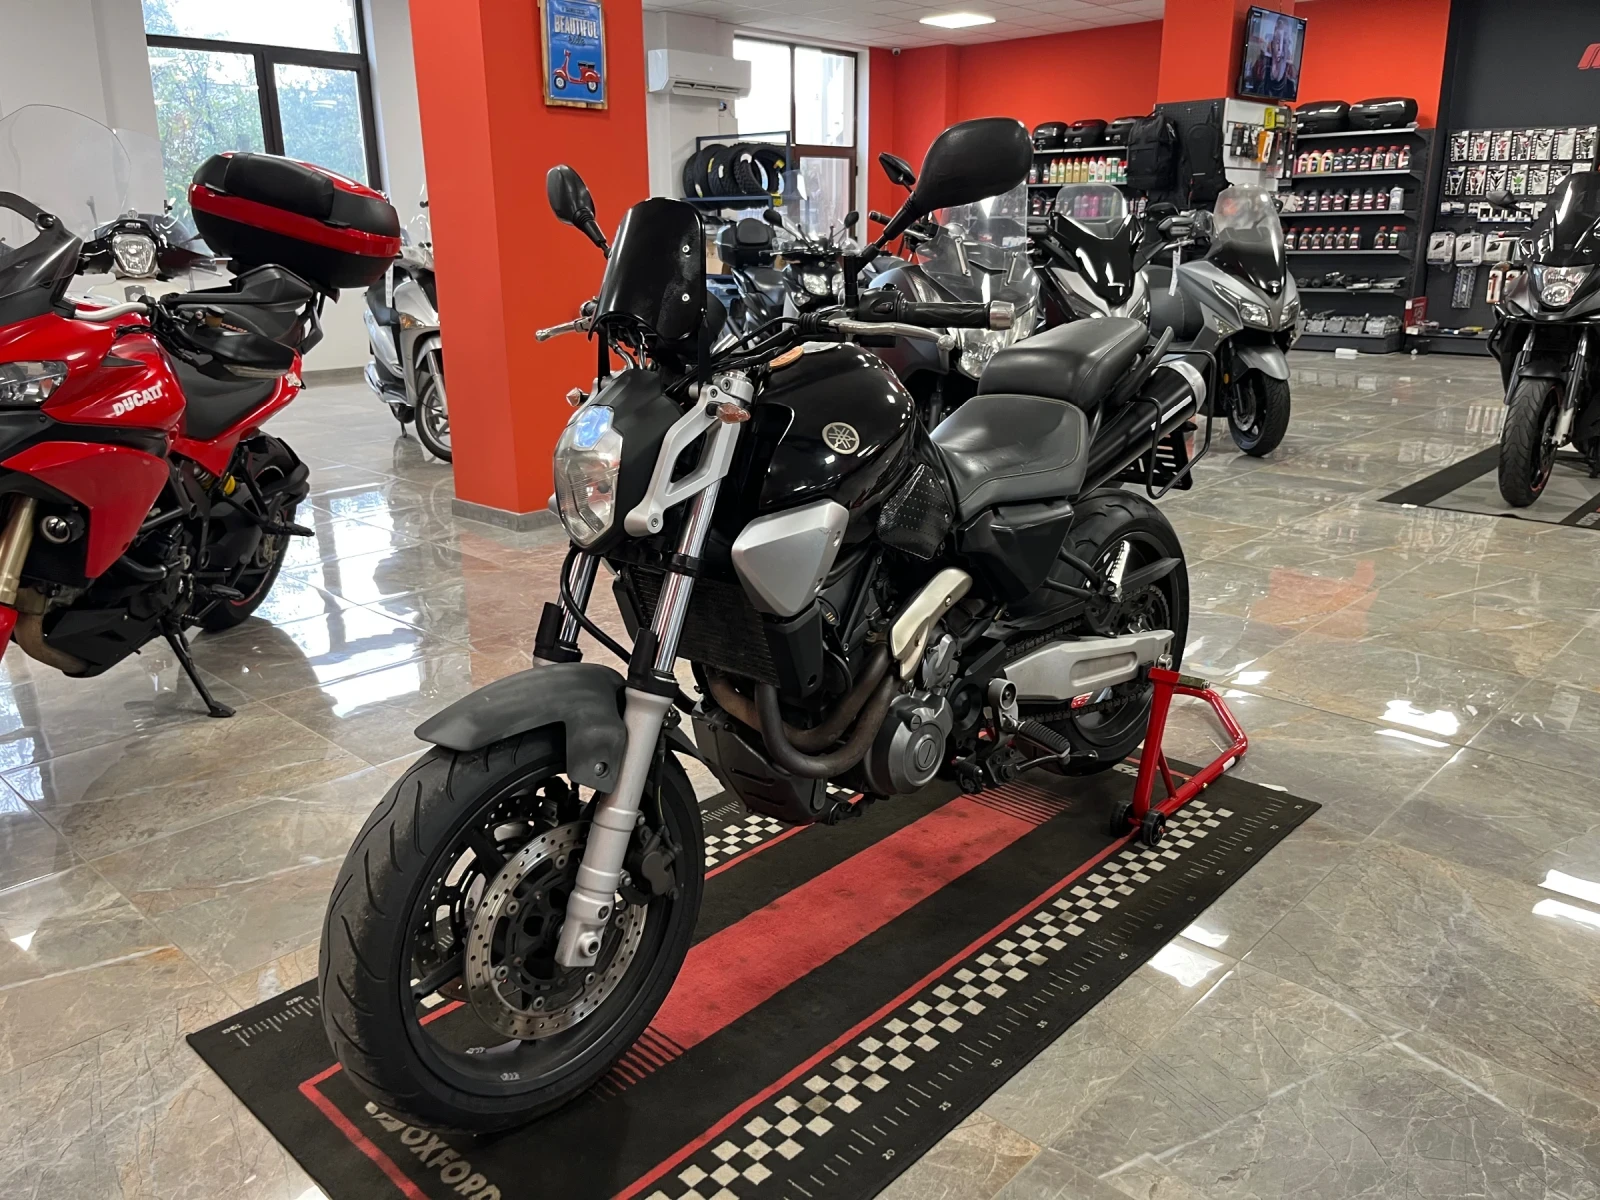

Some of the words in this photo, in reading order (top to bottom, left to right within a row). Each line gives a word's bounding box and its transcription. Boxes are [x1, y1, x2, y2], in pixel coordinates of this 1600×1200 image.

[554, 15, 599, 38] BEAUTIFUL
[112, 383, 163, 417] DUCATI
[882, 1149, 896, 1160] 20
[939, 1101, 952, 1112] 25
[990, 1058, 1003, 1068] 30
[1036, 1020, 1049, 1029] 35
[1080, 984, 1091, 993] 40
